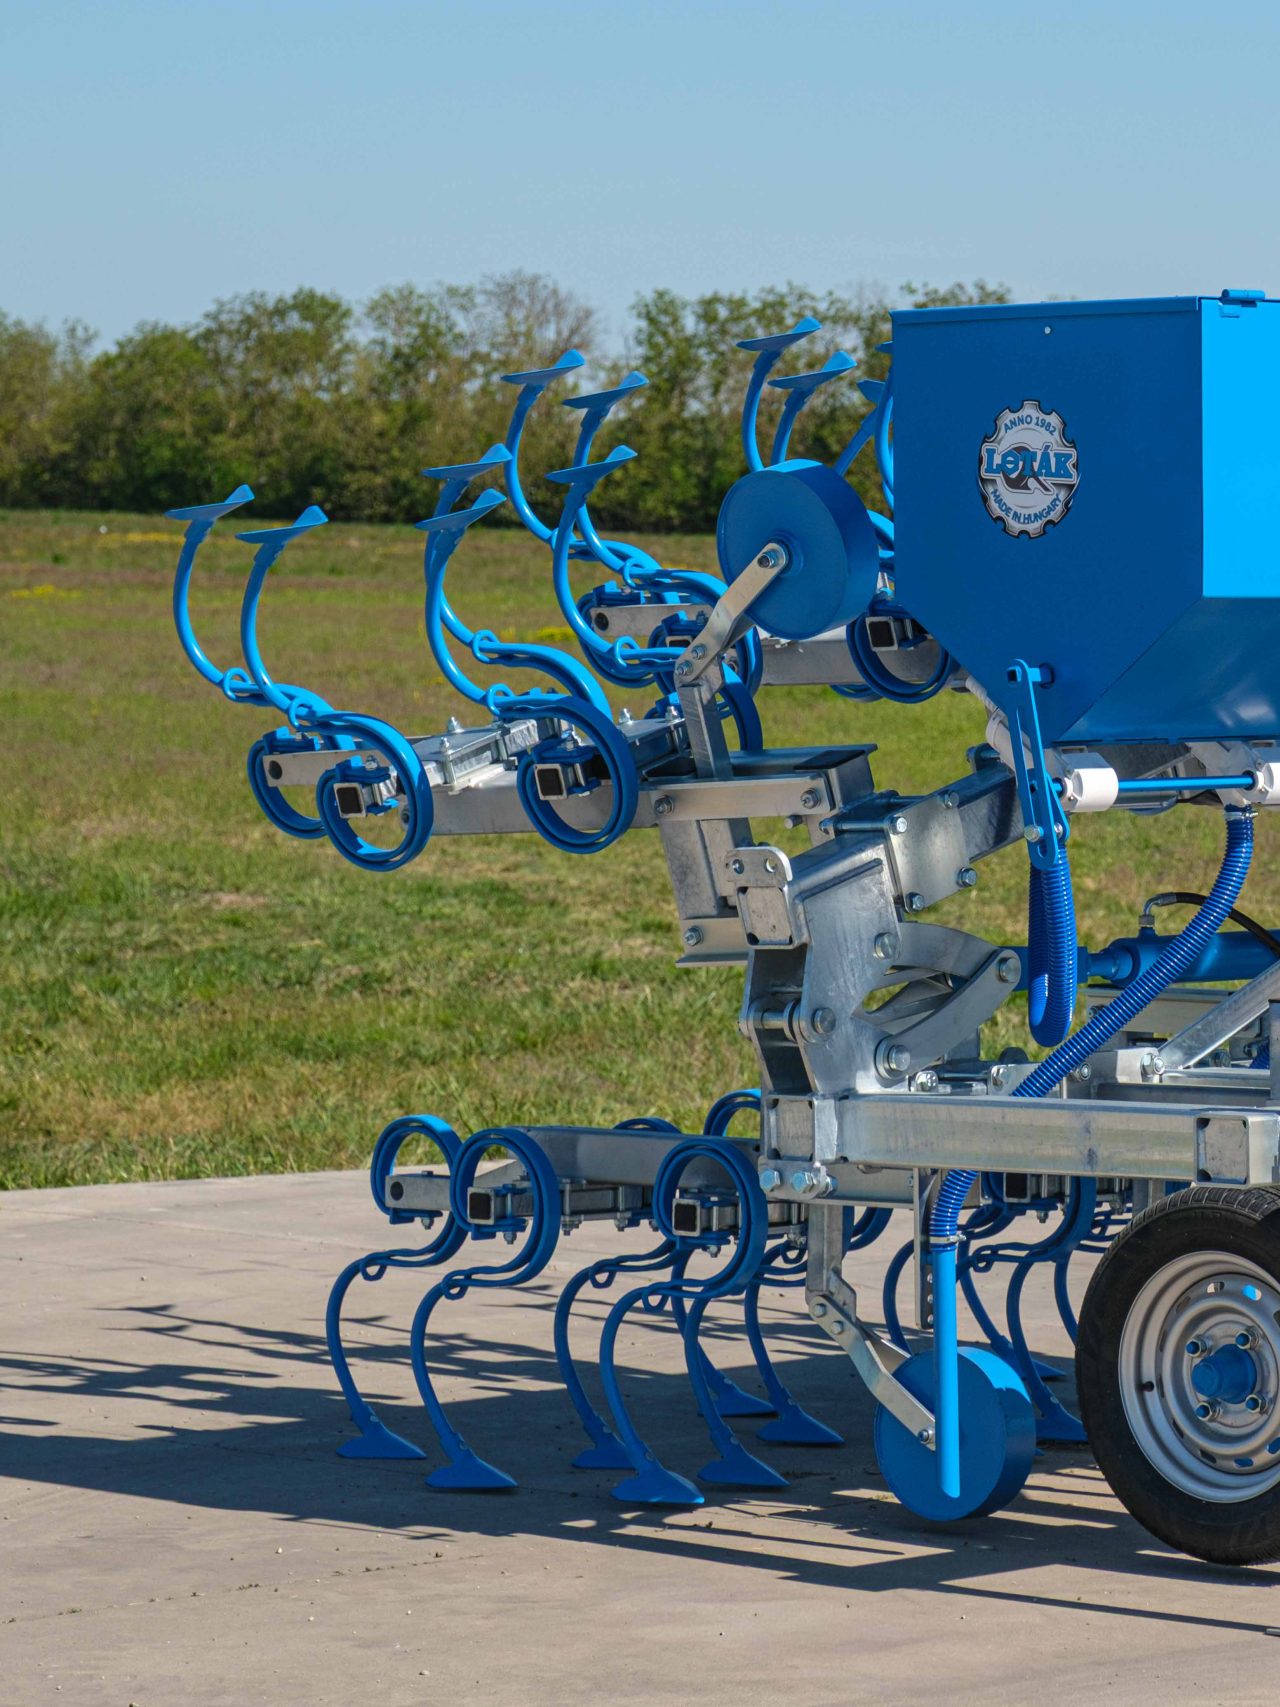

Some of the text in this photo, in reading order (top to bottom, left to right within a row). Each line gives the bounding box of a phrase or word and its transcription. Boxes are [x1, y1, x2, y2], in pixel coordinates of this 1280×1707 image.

[1003, 414, 1057, 436] ANNO 1982
[990, 488, 1062, 525] MADE IN HUNGARY
